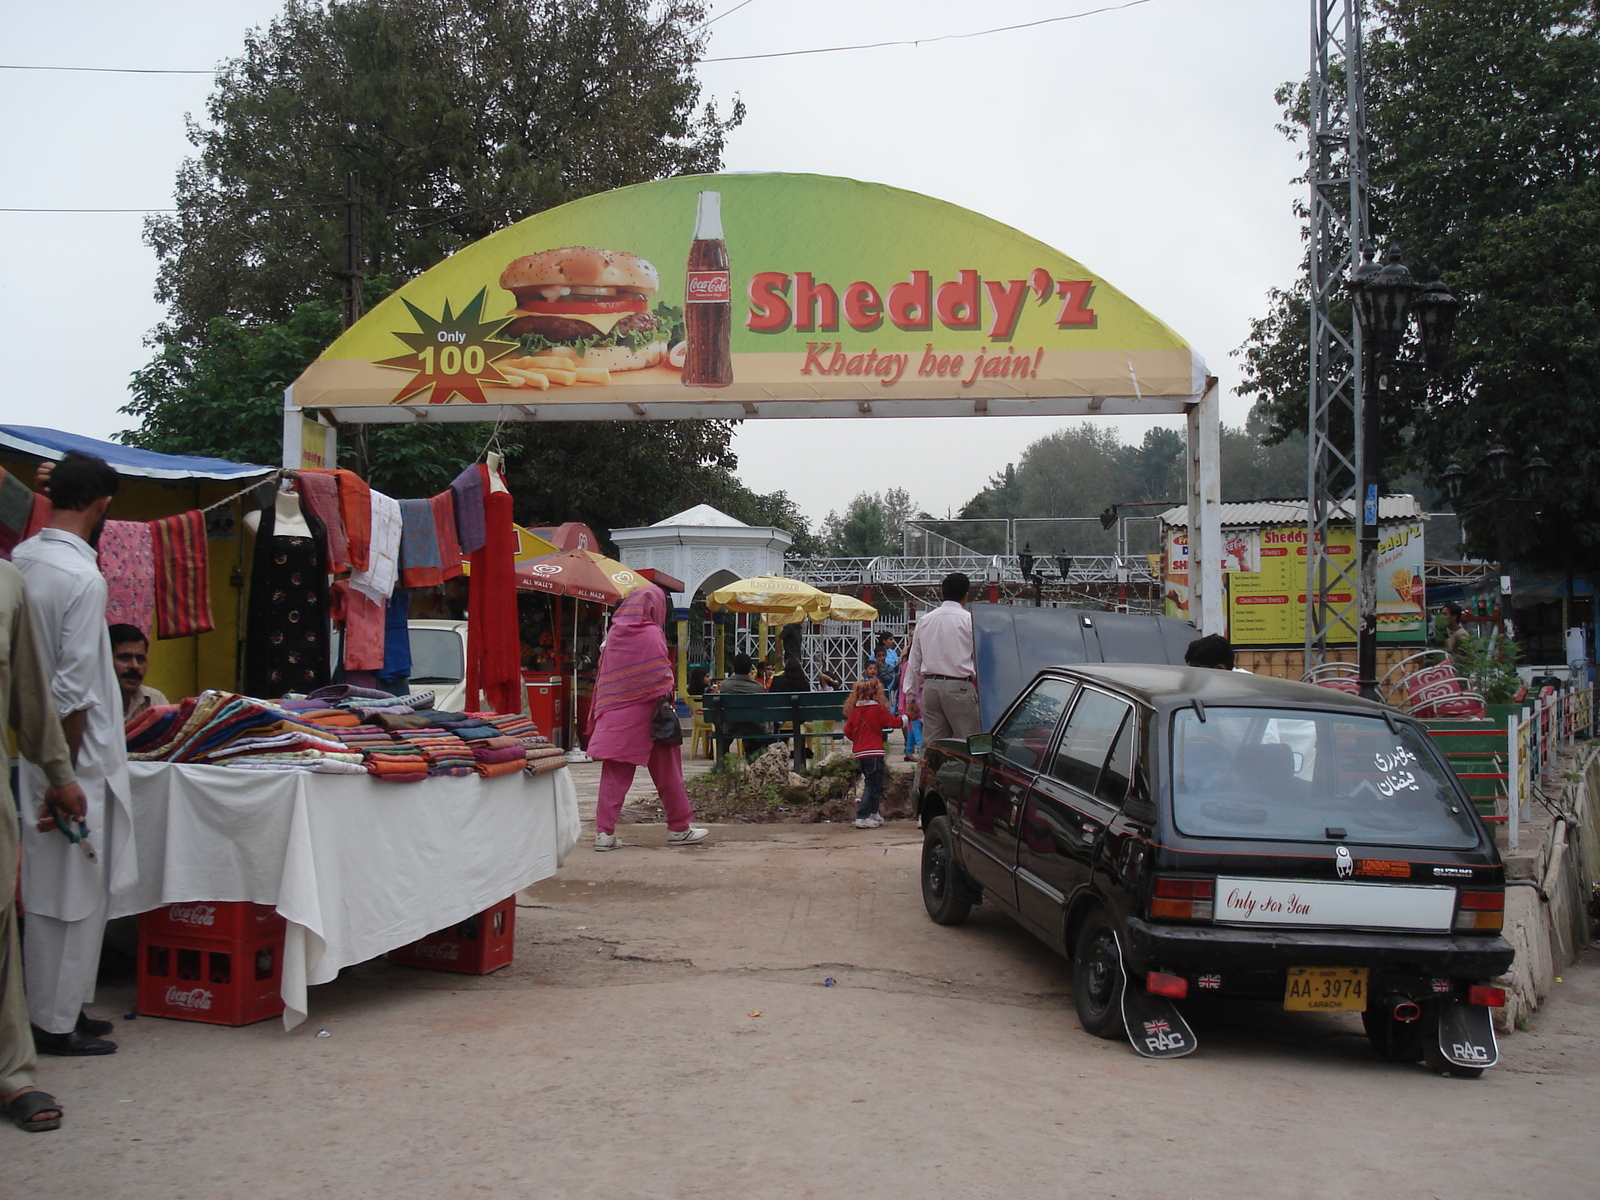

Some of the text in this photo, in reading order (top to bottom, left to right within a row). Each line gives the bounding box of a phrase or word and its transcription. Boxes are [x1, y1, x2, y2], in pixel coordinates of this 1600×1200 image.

[690, 276, 727, 292] Coca-Cola
[745, 267, 1097, 341] Sheddy'z
[437, 330, 466, 345] Only
[418, 345, 485, 375] 100
[801, 341, 1045, 387] Khatay bee jain!
[1264, 530, 1321, 544] Sheddyz
[1377, 525, 1421, 554] eddy'z
[533, 580, 553, 589] WALL'S
[578, 589, 605, 600] ALL MAZA
[1362, 859, 1391, 871] LONDON
[1433, 867, 1473, 878] SUZUKI
[1227, 888, 1312, 919] Only For You
[169, 904, 217, 927] Coca-Cola
[165, 985, 214, 1010] Coca-Cola
[1145, 1032, 1185, 1052] RAC
[1452, 1041, 1488, 1060] RAC
